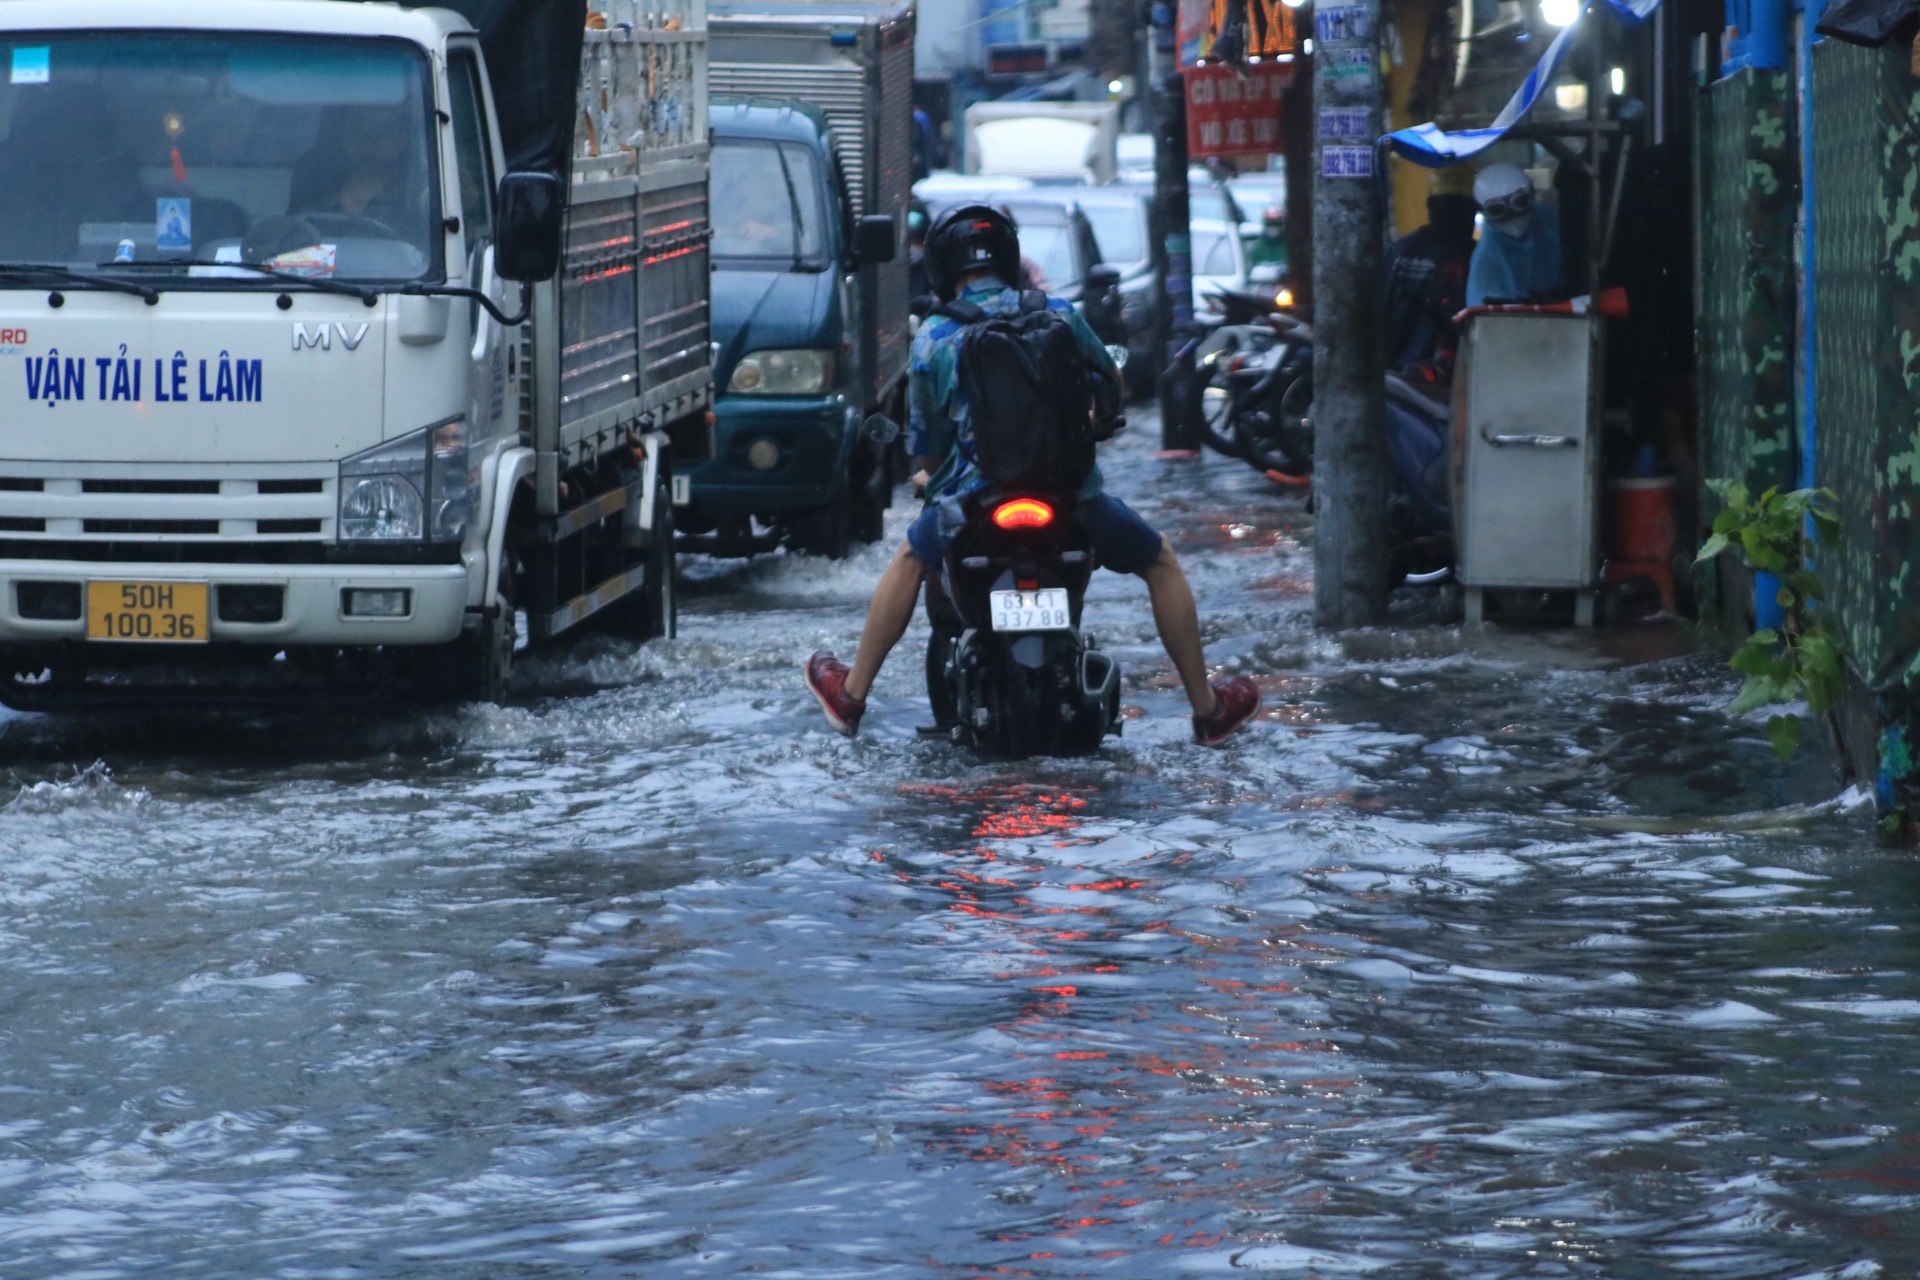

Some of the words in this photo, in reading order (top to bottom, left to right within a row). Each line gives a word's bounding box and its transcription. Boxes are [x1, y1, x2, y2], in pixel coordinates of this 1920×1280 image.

[25, 348, 85, 407] VẬN
[95, 343, 141, 401] TẢI
[155, 351, 188, 402] LÊ
[199, 350, 262, 402] LÂM
[121, 584, 174, 609] 50H
[103, 612, 195, 637] 100.36
[998, 609, 1064, 627] 337.88
